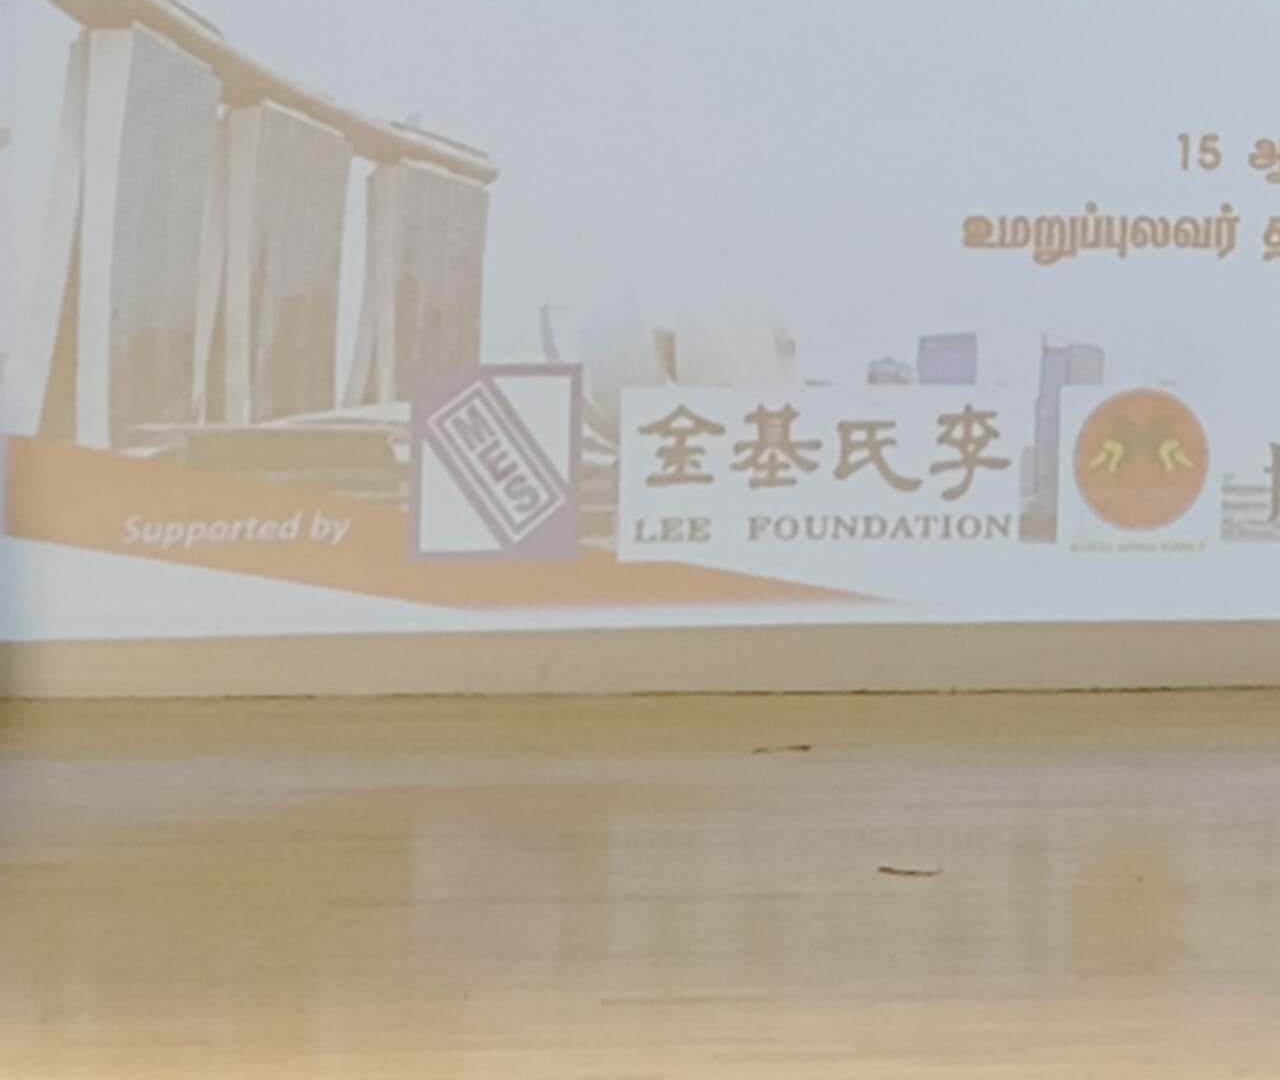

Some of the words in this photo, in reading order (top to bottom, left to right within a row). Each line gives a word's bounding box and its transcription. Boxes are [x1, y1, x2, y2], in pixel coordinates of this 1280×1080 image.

[1177, 133, 1222, 171] 15
[962, 201, 1241, 267] உமறுப்புலவர்
[121, 510, 302, 553] Supported
[309, 511, 351, 545] by
[633, 517, 712, 545] LEE
[747, 513, 1012, 541] FOUNDATION
